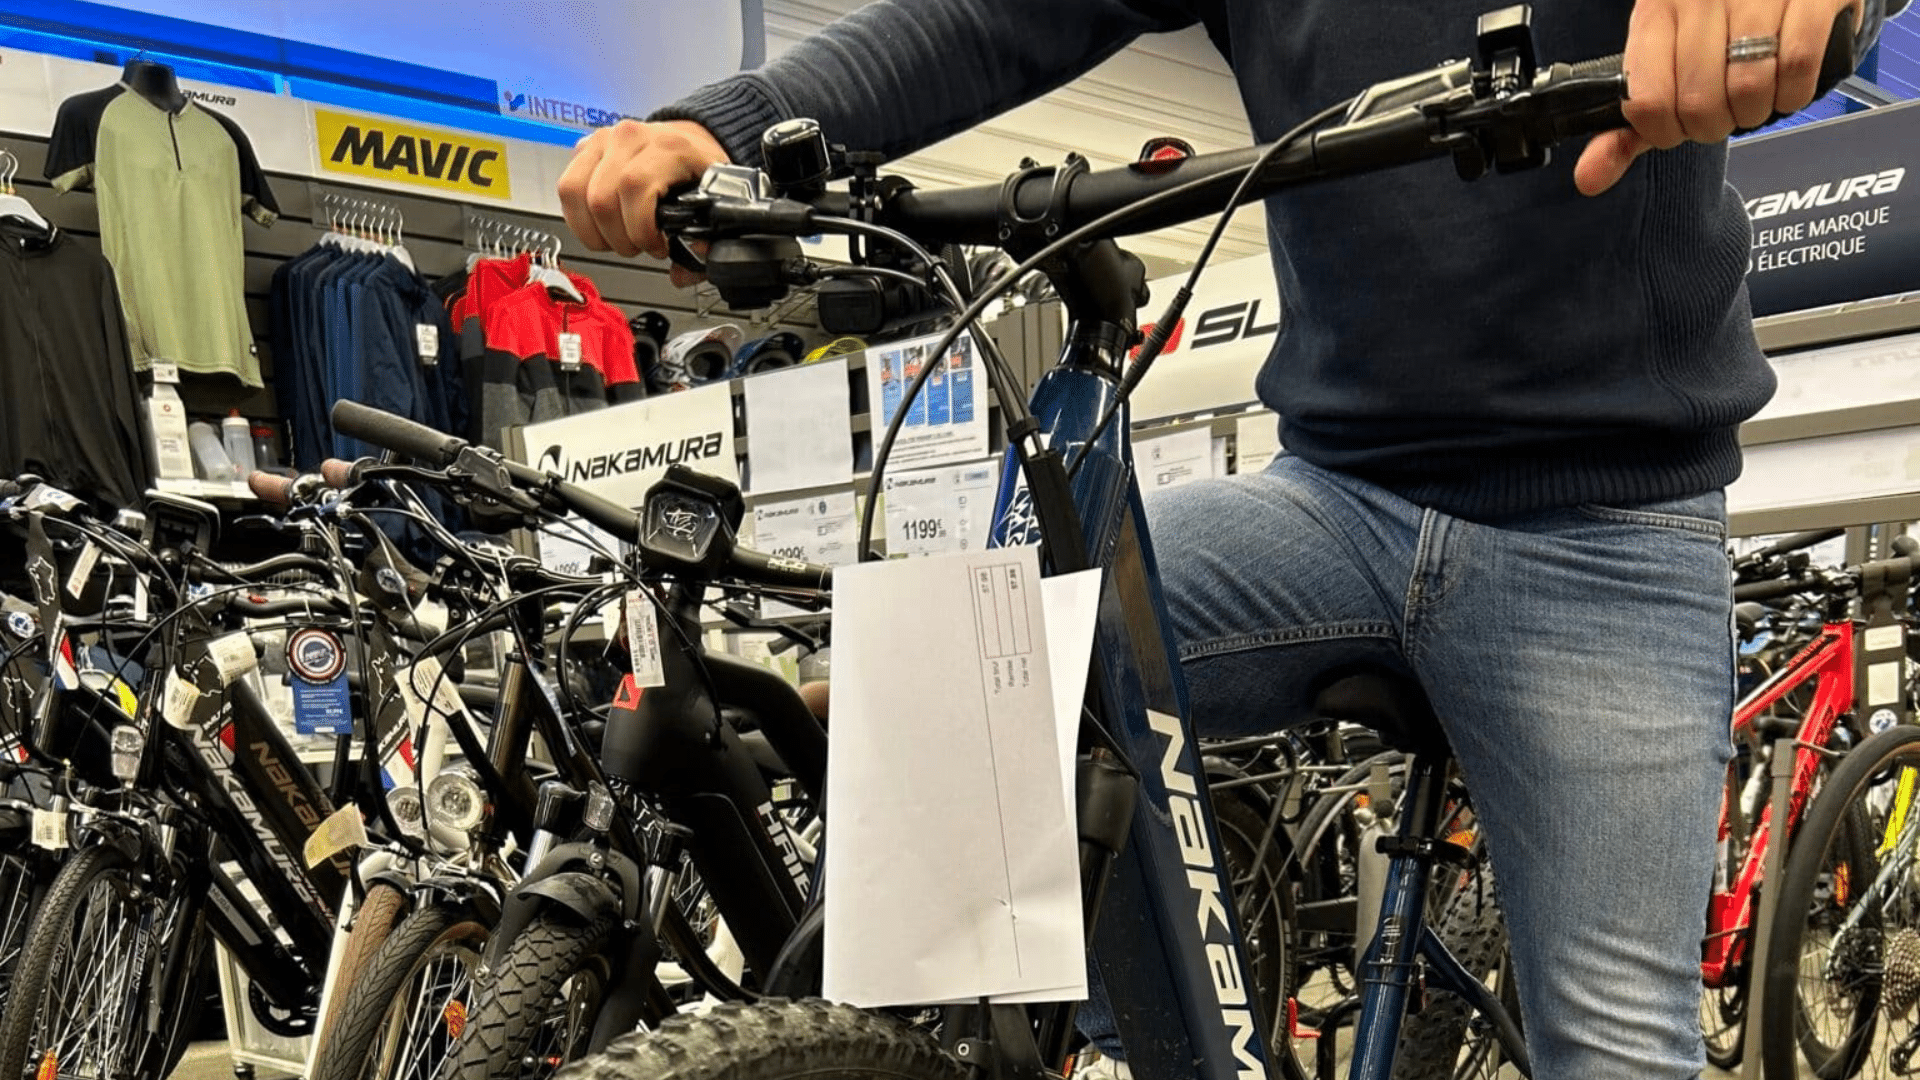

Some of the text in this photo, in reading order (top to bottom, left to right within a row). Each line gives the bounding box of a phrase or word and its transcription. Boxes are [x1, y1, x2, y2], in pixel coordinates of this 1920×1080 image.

[330, 125, 499, 187] MAVIC
[1809, 206, 1890, 238] MARQUE
[1758, 235, 1867, 272] ÉLECTRIQUE
